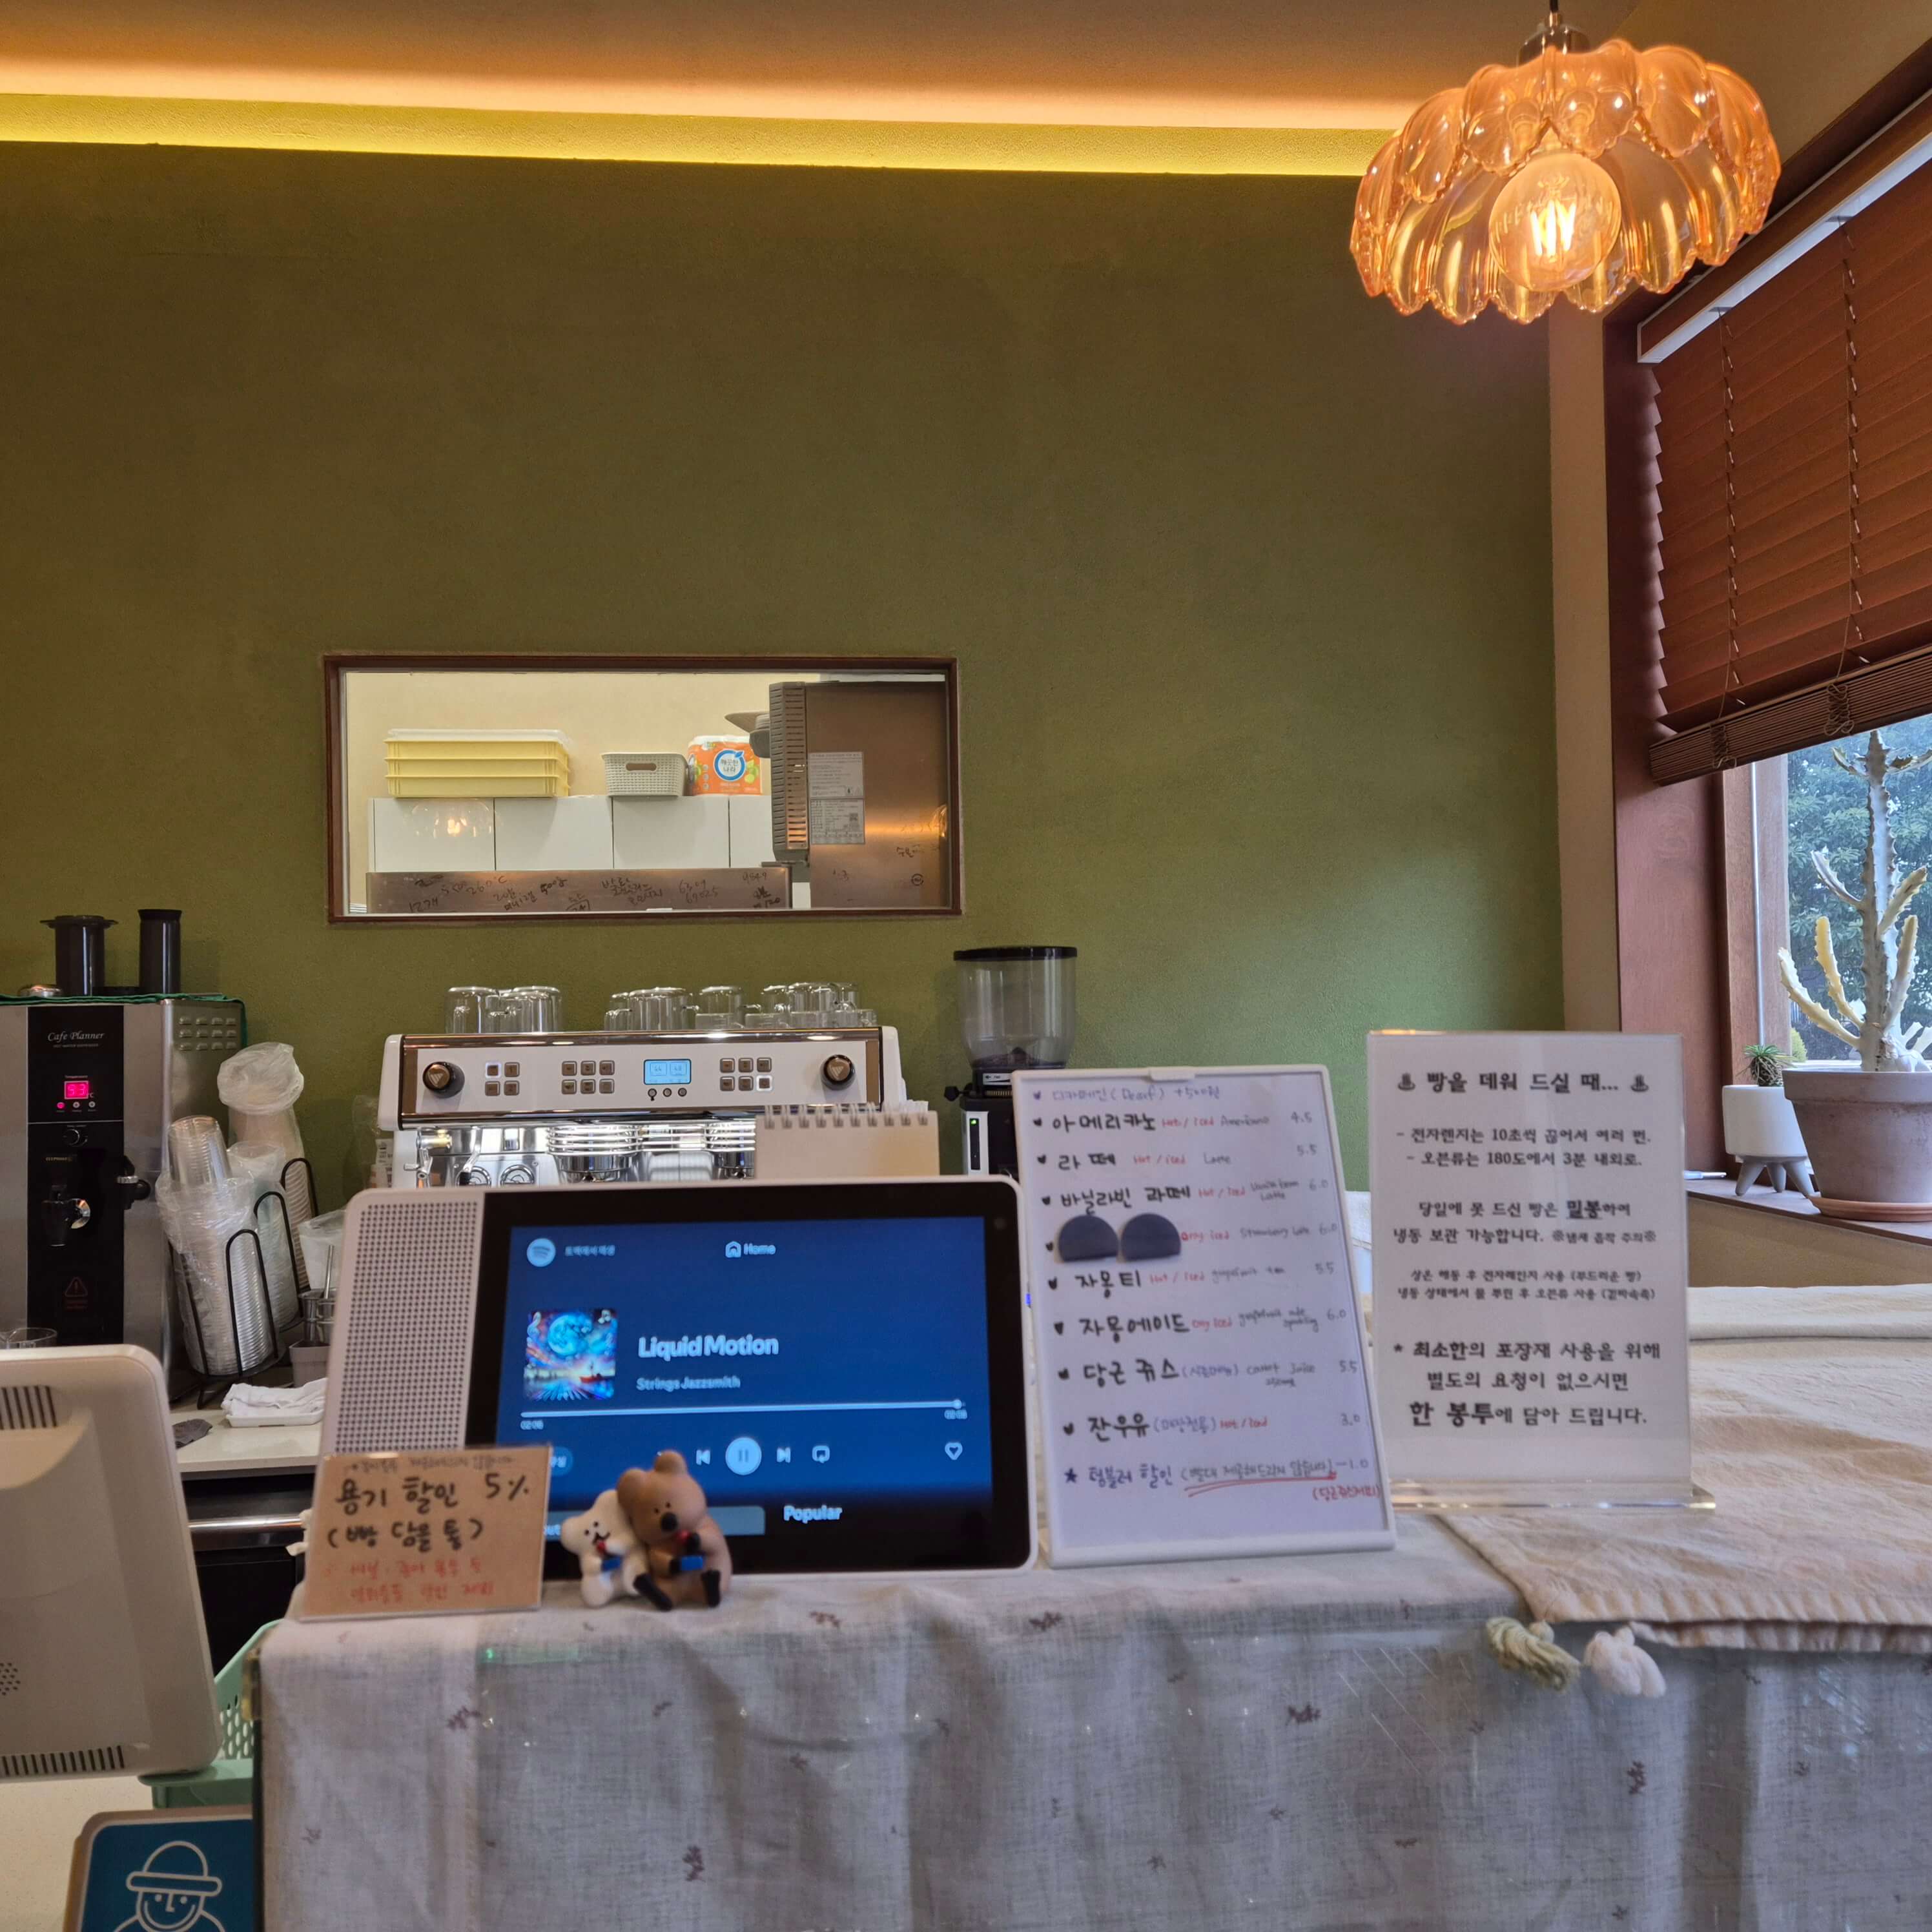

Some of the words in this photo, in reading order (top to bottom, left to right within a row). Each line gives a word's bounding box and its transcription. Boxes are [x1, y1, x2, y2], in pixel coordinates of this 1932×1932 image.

[47, 1031, 68, 1043] Cafe
[70, 1031, 105, 1040] Planner
[1426, 1072, 1467, 1093] 빵을
[1479, 1072, 1517, 1091] 데워
[1529, 1073, 1570, 1093] 드실
[1052, 1113, 1156, 1134] 아메리카노
[1410, 1127, 1484, 1144] 전자렌지는
[1491, 1127, 1537, 1144] 10초씩
[1596, 1129, 1625, 1143] 여러
[1632, 1129, 1651, 1145] 번.
[1421, 1152, 1479, 1167] 오븐류는
[1486, 1151, 1555, 1166] 180도에서
[1563, 1152, 1586, 1168] 3분
[1594, 1152, 1642, 1167] 내외로.
[1060, 1186, 1132, 1216] 바닐라빈
[1144, 1184, 1191, 1202] 라떼
[1419, 1201, 1463, 1218] 당일에
[1470, 1202, 1485, 1217] 못
[1492, 1202, 1522, 1217] 드신
[1528, 1202, 1559, 1219] 빵은
[1565, 1199, 1631, 1220] 밀봉하여
[1393, 1228, 1422, 1244] 냉동
[1430, 1228, 1459, 1244] 보관
[1466, 1228, 1544, 1245] 가능합니다.
[743, 1243, 776, 1255] Home
[1074, 1269, 1142, 1299] 자몽티
[1411, 1269, 1433, 1282] 상온
[1438, 1269, 1461, 1282] 해동
[1466, 1269, 1477, 1280] 후
[1483, 1269, 1538, 1282] 전자레인지
[1543, 1270, 1565, 1282] 사용
[1397, 1287, 1419, 1300] 냉동
[1424, 1287, 1469, 1300] 상태에서
[1519, 1288, 1530, 1299] 후
[1574, 1288, 1596, 1301] 사용
[1078, 1313, 1191, 1344] 자몽에이드
[638, 1335, 702, 1362] Liquid
[704, 1333, 779, 1357] Motion
[1413, 1341, 1485, 1361] 최소한의
[1495, 1342, 1551, 1361] 포장재
[1560, 1342, 1615, 1361] 사용을
[1625, 1342, 1661, 1360] 위해
[1082, 1358, 1126, 1388] 당근
[1427, 1372, 1481, 1391] 별도의
[1492, 1372, 1546, 1392] 요청이
[1557, 1372, 1629, 1392] 없으시면
[636, 1377, 680, 1393] Strings
[681, 1375, 741, 1390] Jazzsmith
[1410, 1401, 1434, 1427] 한
[1446, 1402, 1514, 1428] 봉투에
[1523, 1406, 1560, 1426] 담아
[1569, 1407, 1647, 1427] 드립니다.
[1089, 1412, 1149, 1443] 잔우유
[1088, 1466, 1133, 1489] 텀블러
[1138, 1463, 1173, 1489] 할인
[335, 1478, 387, 1516] 용기
[401, 1476, 458, 1514] 할인
[484, 1472, 529, 1501] 5%
[783, 1504, 843, 1525] Popular
[391, 1518, 433, 1553] 담을
